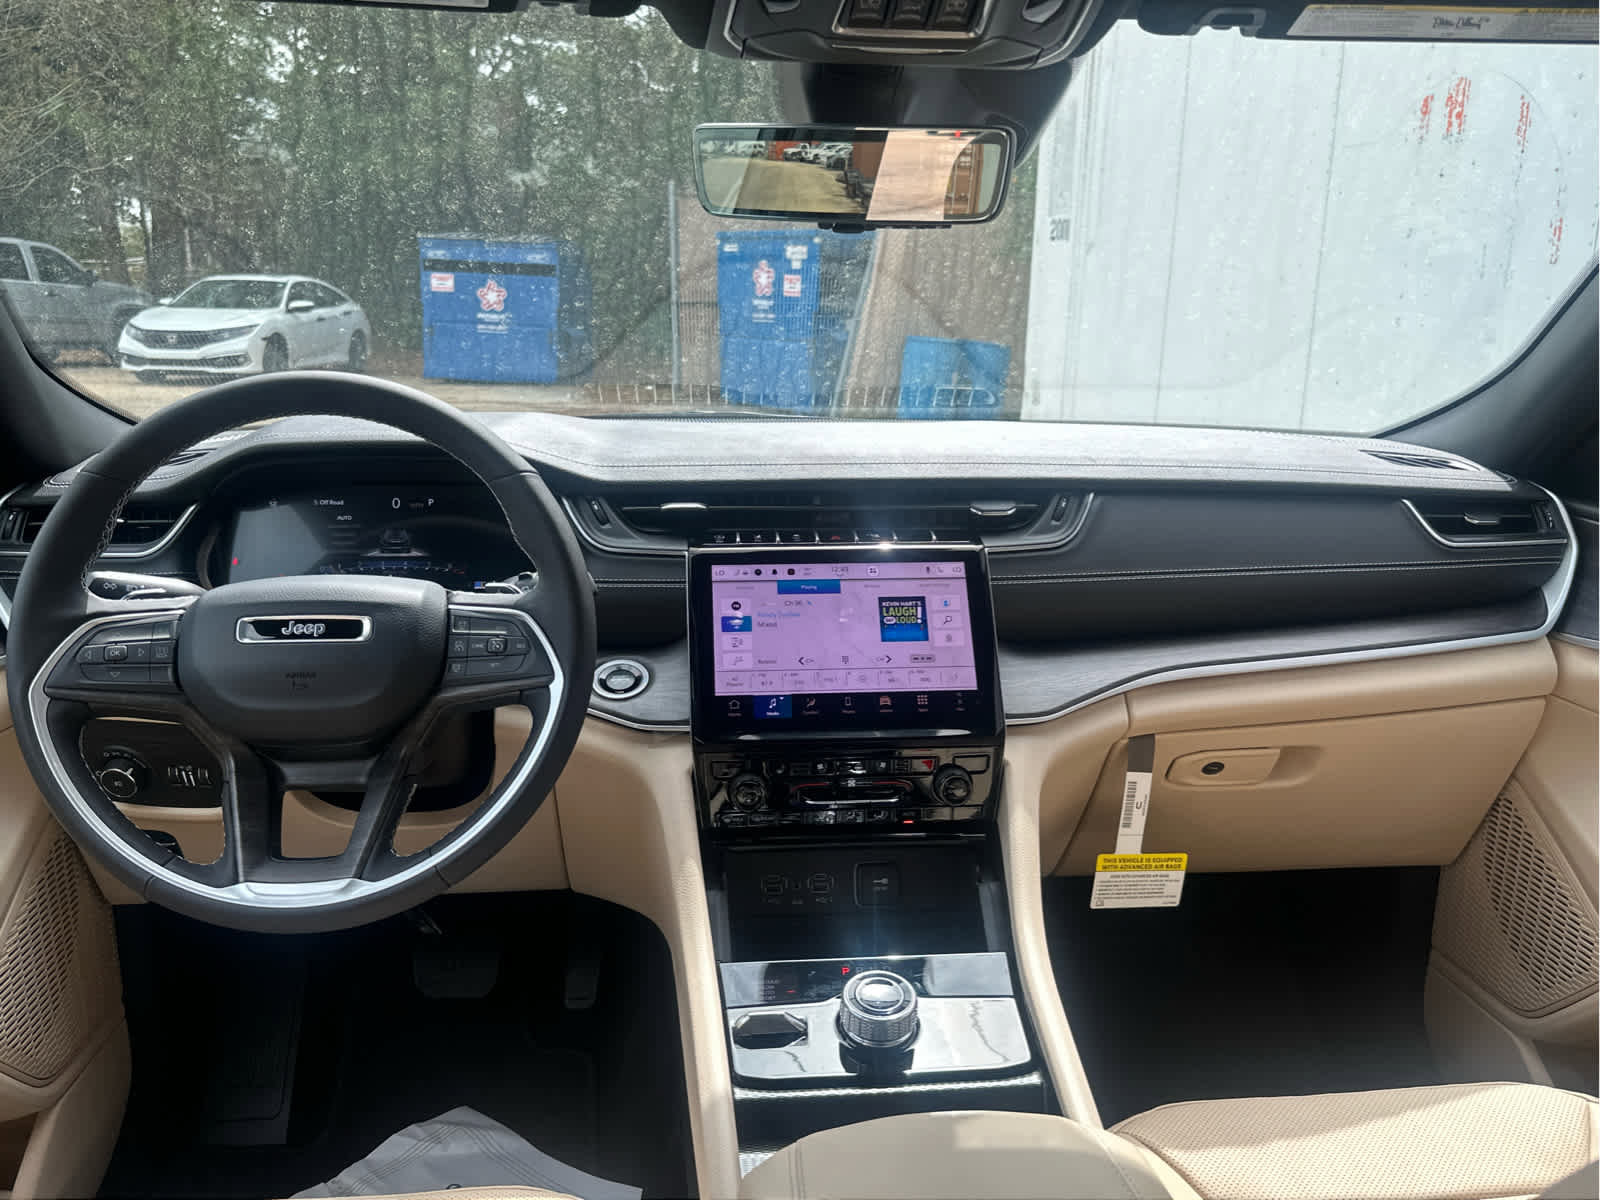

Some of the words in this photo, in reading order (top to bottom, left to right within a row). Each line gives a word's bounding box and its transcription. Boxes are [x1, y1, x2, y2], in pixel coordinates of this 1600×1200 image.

[391, 497, 401, 509] 0
[882, 606, 917, 617] LAUGH
[281, 620, 326, 637] Jeep
[841, 967, 850, 975] P
